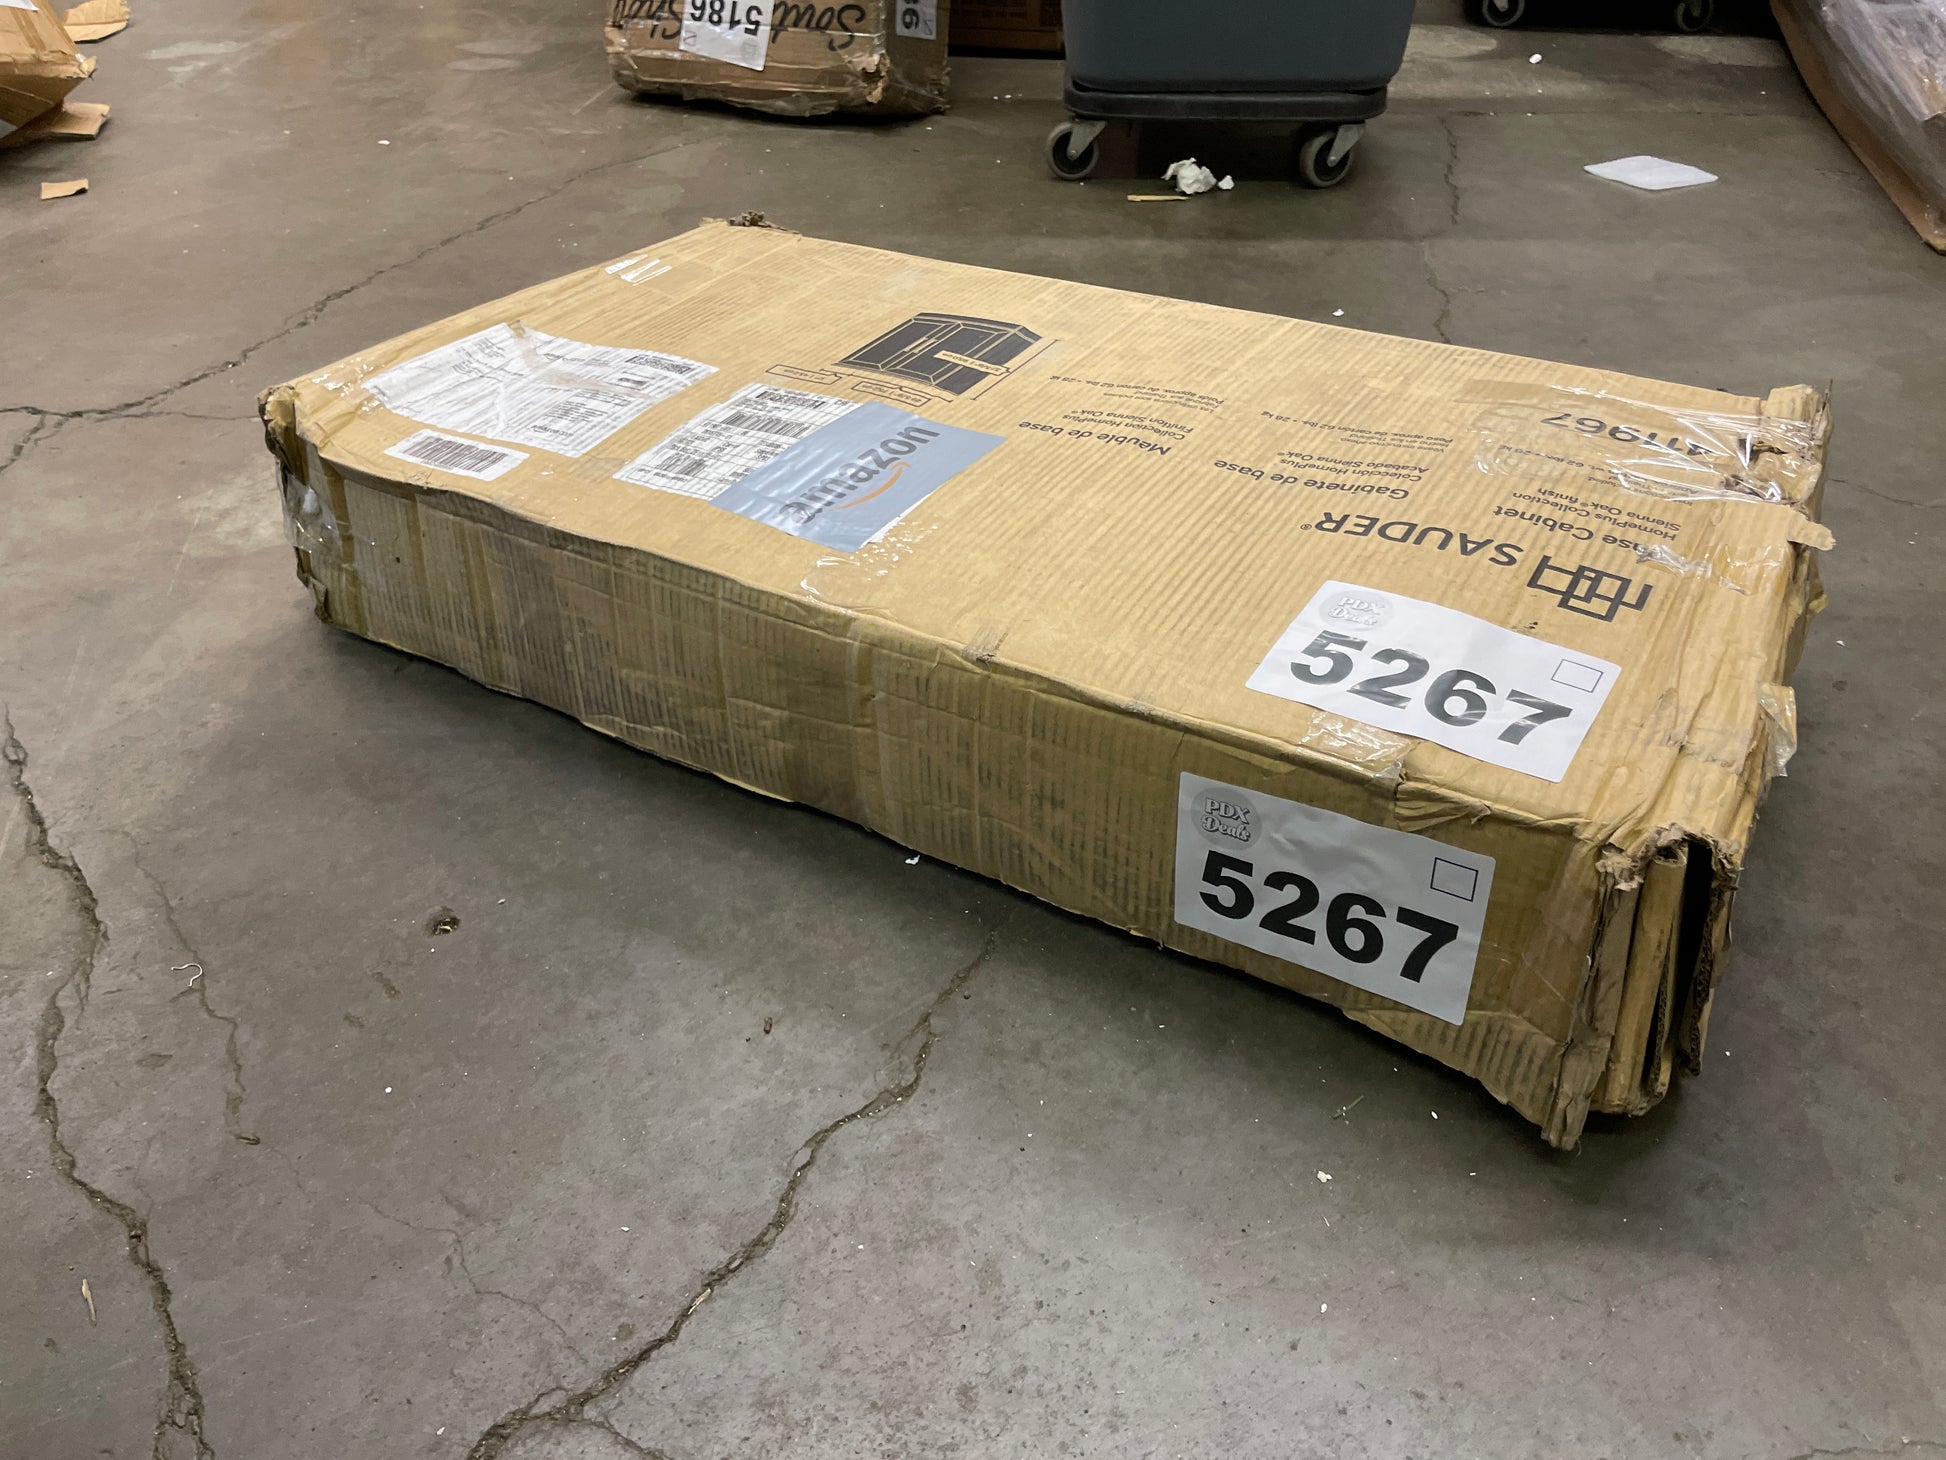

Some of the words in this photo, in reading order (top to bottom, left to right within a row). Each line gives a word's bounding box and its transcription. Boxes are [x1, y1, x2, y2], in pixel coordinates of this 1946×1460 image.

[691, 0, 763, 35] 5186
[1061, 414, 1123, 427] HomePlus
[1104, 412, 1147, 422] Sienna
[1147, 417, 1194, 433] Finition
[1017, 421, 1065, 435] base
[1066, 429, 1093, 438] de
[1123, 422, 1186, 440] Collection
[1095, 433, 1172, 455] Meuble
[1212, 459, 1266, 480] base
[1278, 458, 1349, 475] HomePlus
[1315, 456, 1363, 467] Sienna
[1365, 462, 1429, 473] Acabado
[781, 426, 940, 524] amazon
[1268, 473, 1298, 484] de
[1350, 469, 1422, 481] Colección
[1302, 479, 1408, 500] Gabinete
[1536, 487, 1579, 503] finish
[1511, 492, 1590, 517] Collection
[1492, 505, 1595, 541] Cabinet
[1593, 513, 1677, 540] HomePlus
[1626, 511, 1681, 531] Sienna
[1338, 595, 1384, 615] PDX
[1291, 629, 1572, 746] 5267
[1205, 797, 1249, 824] PDX
[1202, 815, 1251, 842] Deals
[1199, 850, 1459, 983] 5267
